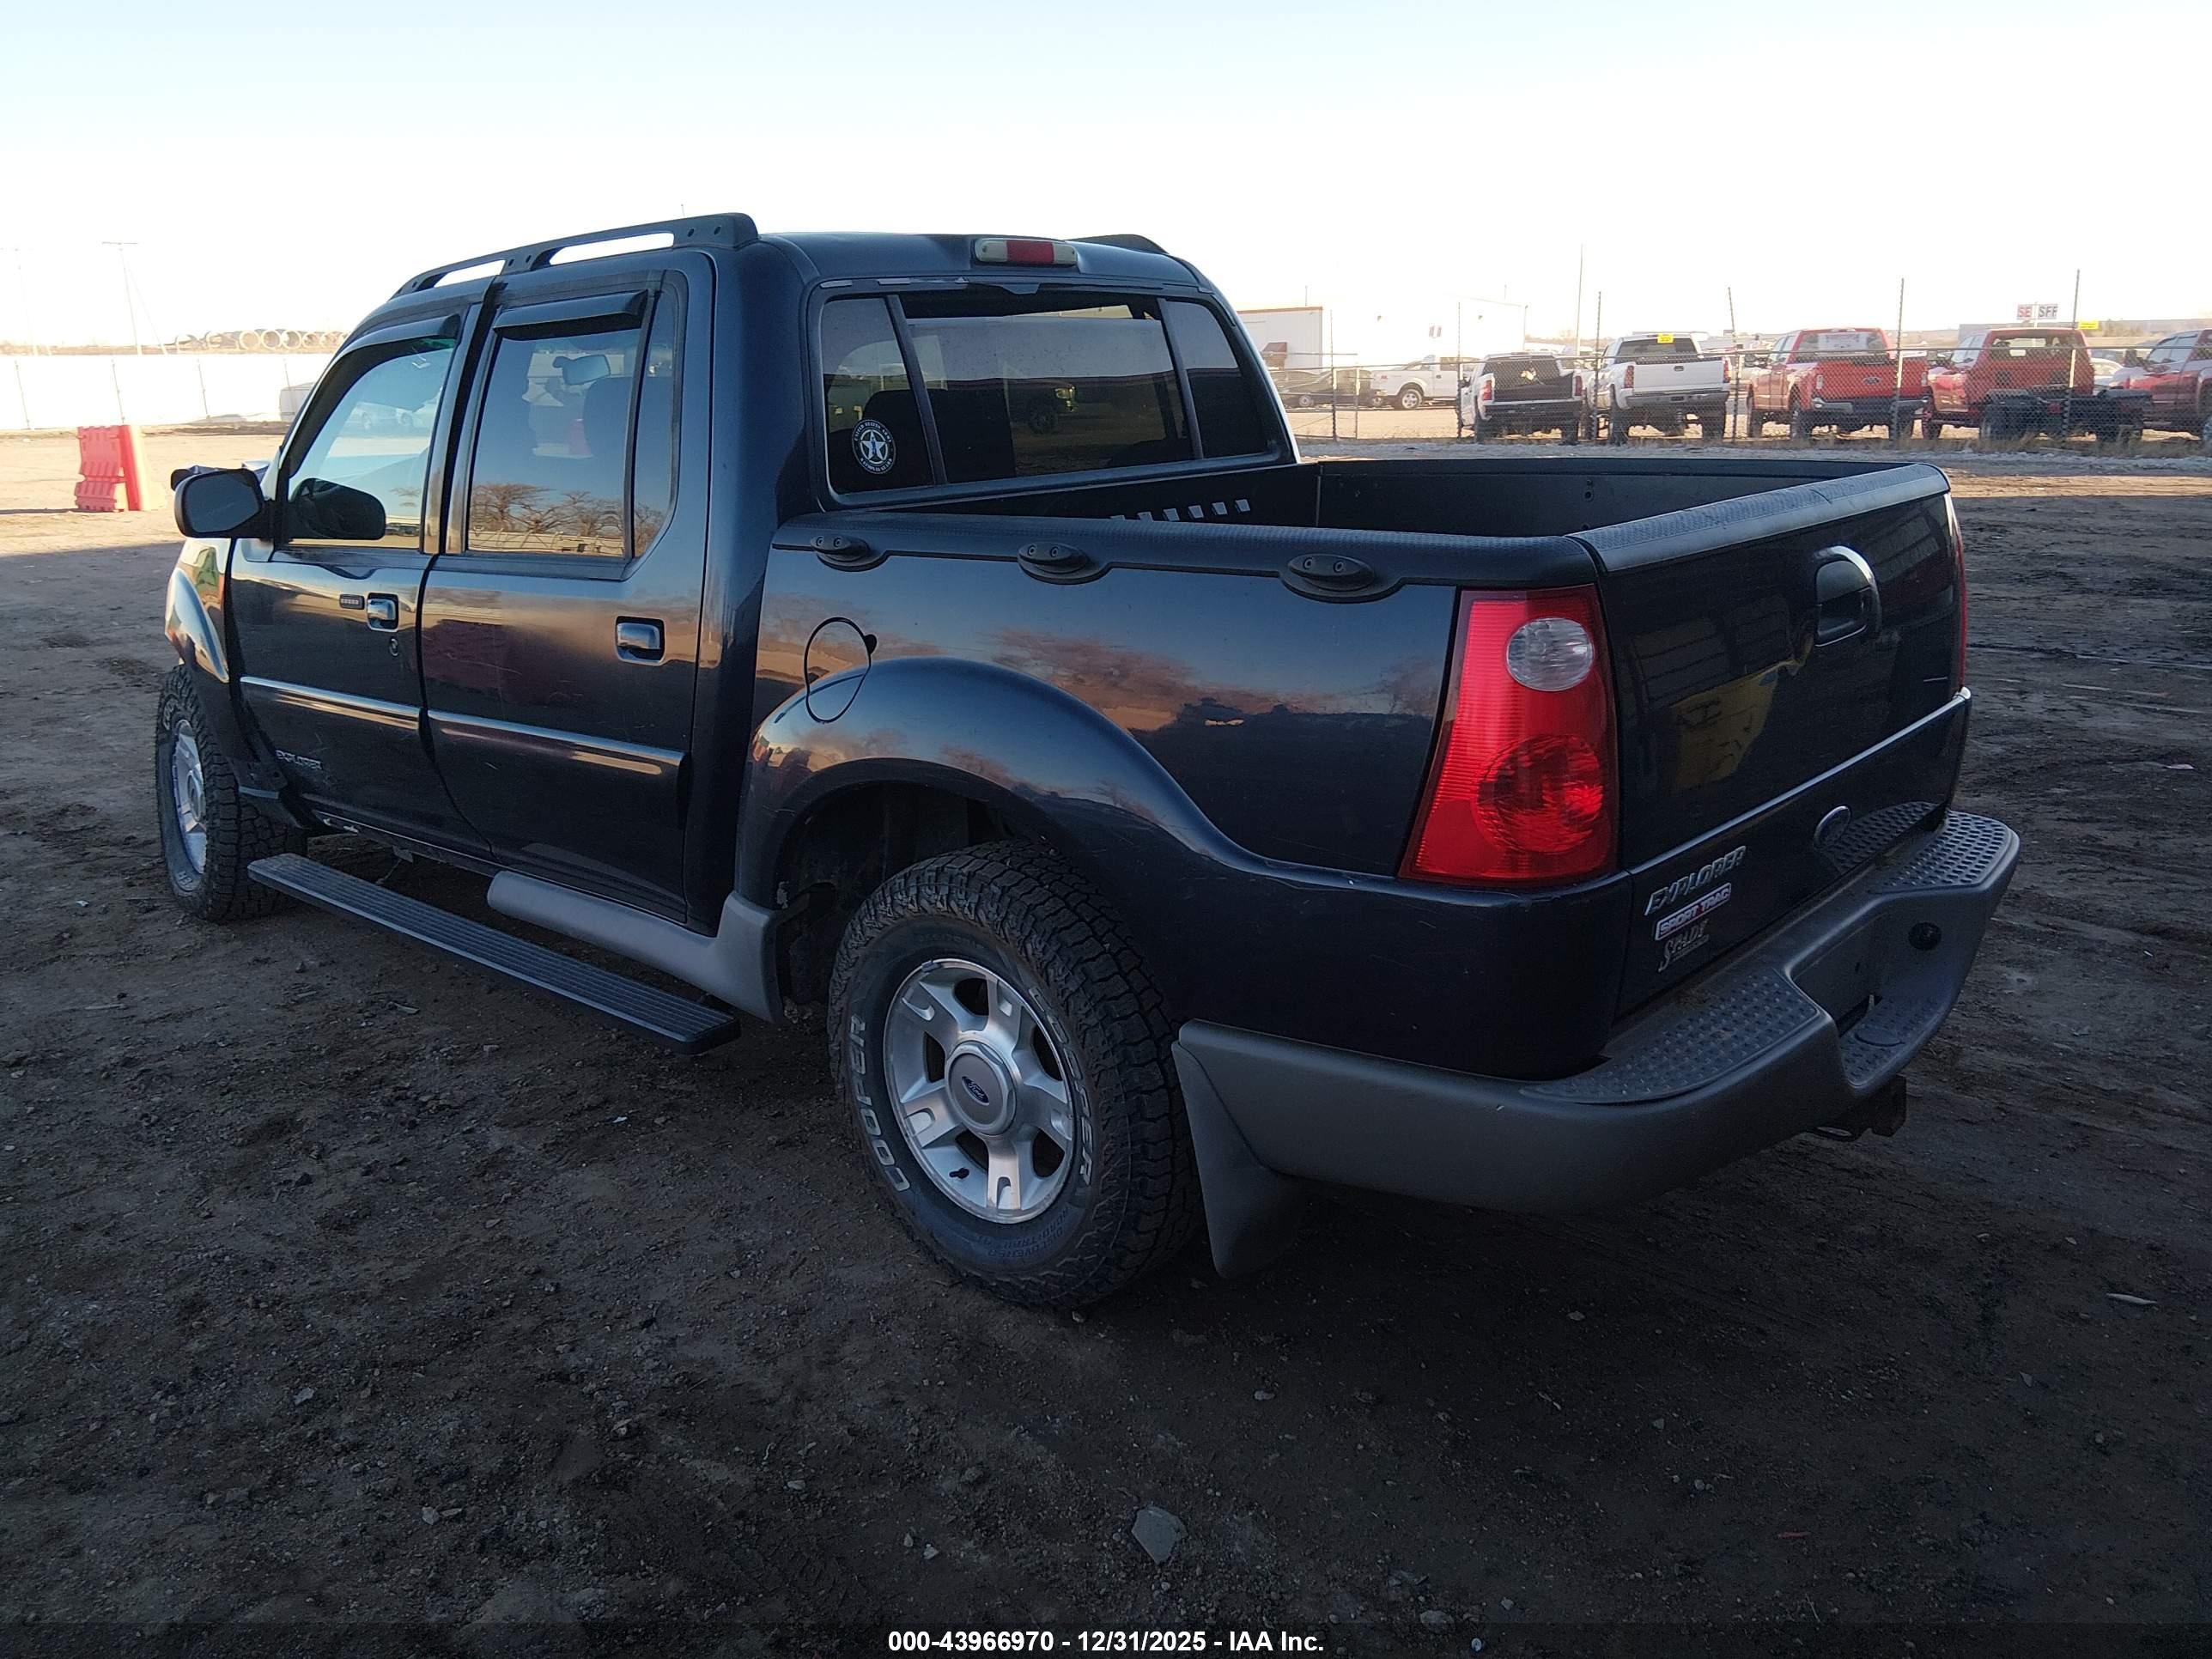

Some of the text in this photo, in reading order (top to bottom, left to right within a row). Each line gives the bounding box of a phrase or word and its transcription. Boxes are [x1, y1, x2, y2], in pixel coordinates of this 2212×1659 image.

[276, 749, 323, 770] EXPLORER
[1644, 845, 1747, 916] EXPLORER
[1660, 888, 1729, 936] SPORT TRAC
[849, 1014, 911, 1192] COOPER
